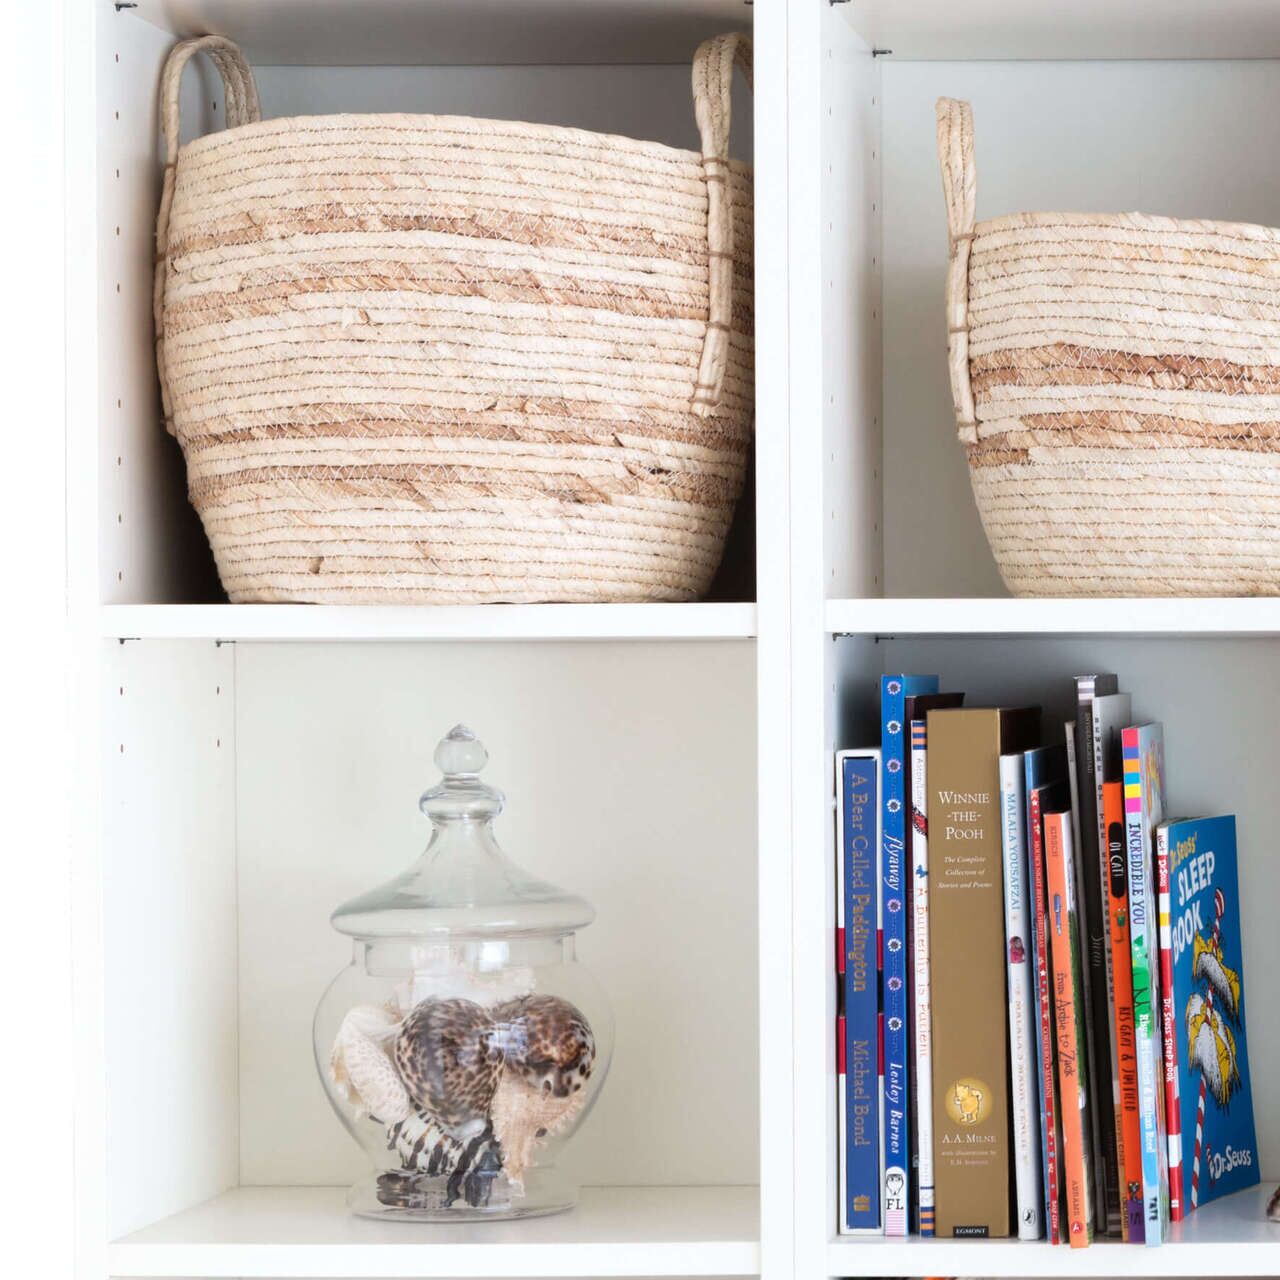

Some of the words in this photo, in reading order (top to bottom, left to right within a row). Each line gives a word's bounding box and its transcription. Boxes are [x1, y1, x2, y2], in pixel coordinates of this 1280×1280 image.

[852, 773, 867, 789] A
[938, 791, 990, 805] WINNIE
[852, 793, 869, 831] Bear
[945, 826, 984, 840] POOH
[852, 835, 870, 888] Called
[882, 835, 904, 890] flyaway
[1129, 823, 1145, 897] INCREDIBLE
[1177, 851, 1216, 906] SLEEP
[1132, 900, 1147, 926] YOU
[847, 893, 869, 992] Paddington
[1171, 914, 1204, 962] BOOK
[852, 1040, 870, 1100] Michael
[886, 1062, 903, 1104] Lesley
[852, 1104, 870, 1147] Bond
[890, 1109, 903, 1154] Barnes
